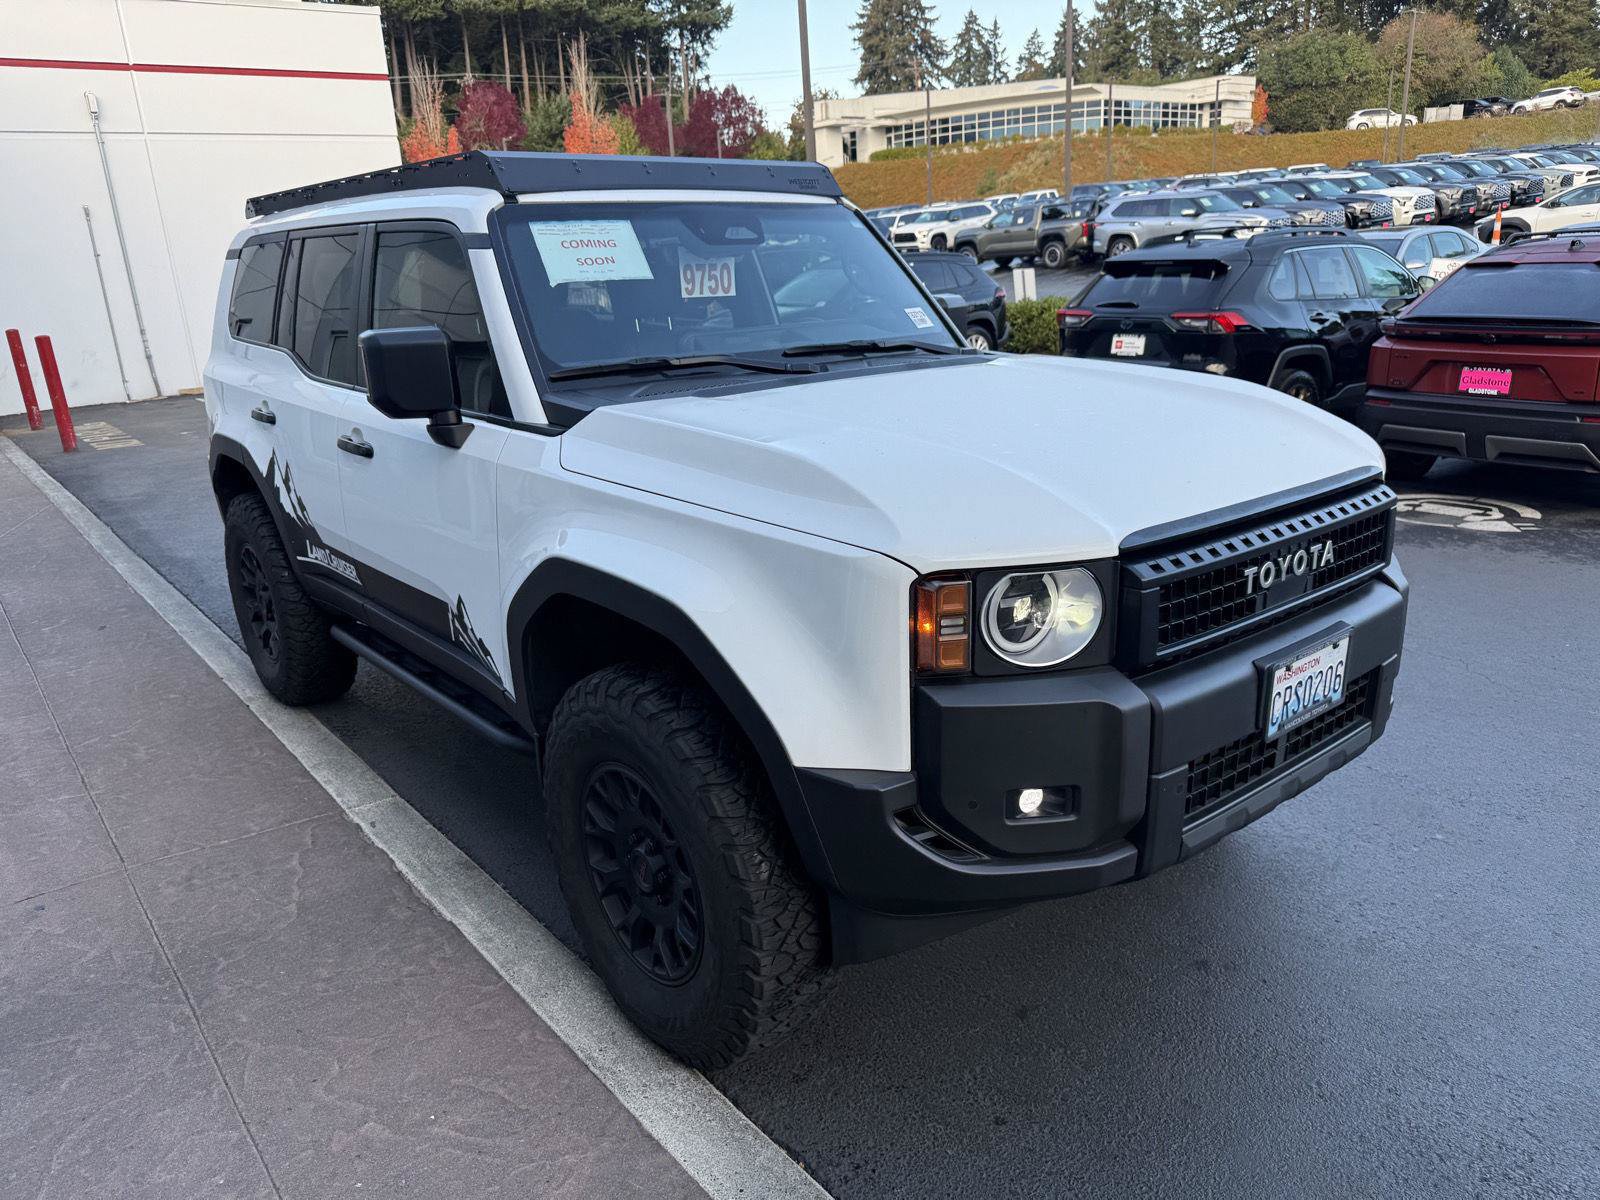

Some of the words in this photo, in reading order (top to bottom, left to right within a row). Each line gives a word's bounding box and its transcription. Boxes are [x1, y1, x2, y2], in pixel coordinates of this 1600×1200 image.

[561, 239, 617, 249] COMING
[576, 256, 616, 266] SOON
[682, 262, 732, 296] 9750
[1462, 375, 1510, 387] Gladstone
[1244, 540, 1335, 595] TOYOTA
[1276, 656, 1321, 685] WASHINGTON
[1270, 660, 1344, 726] CRS0206
